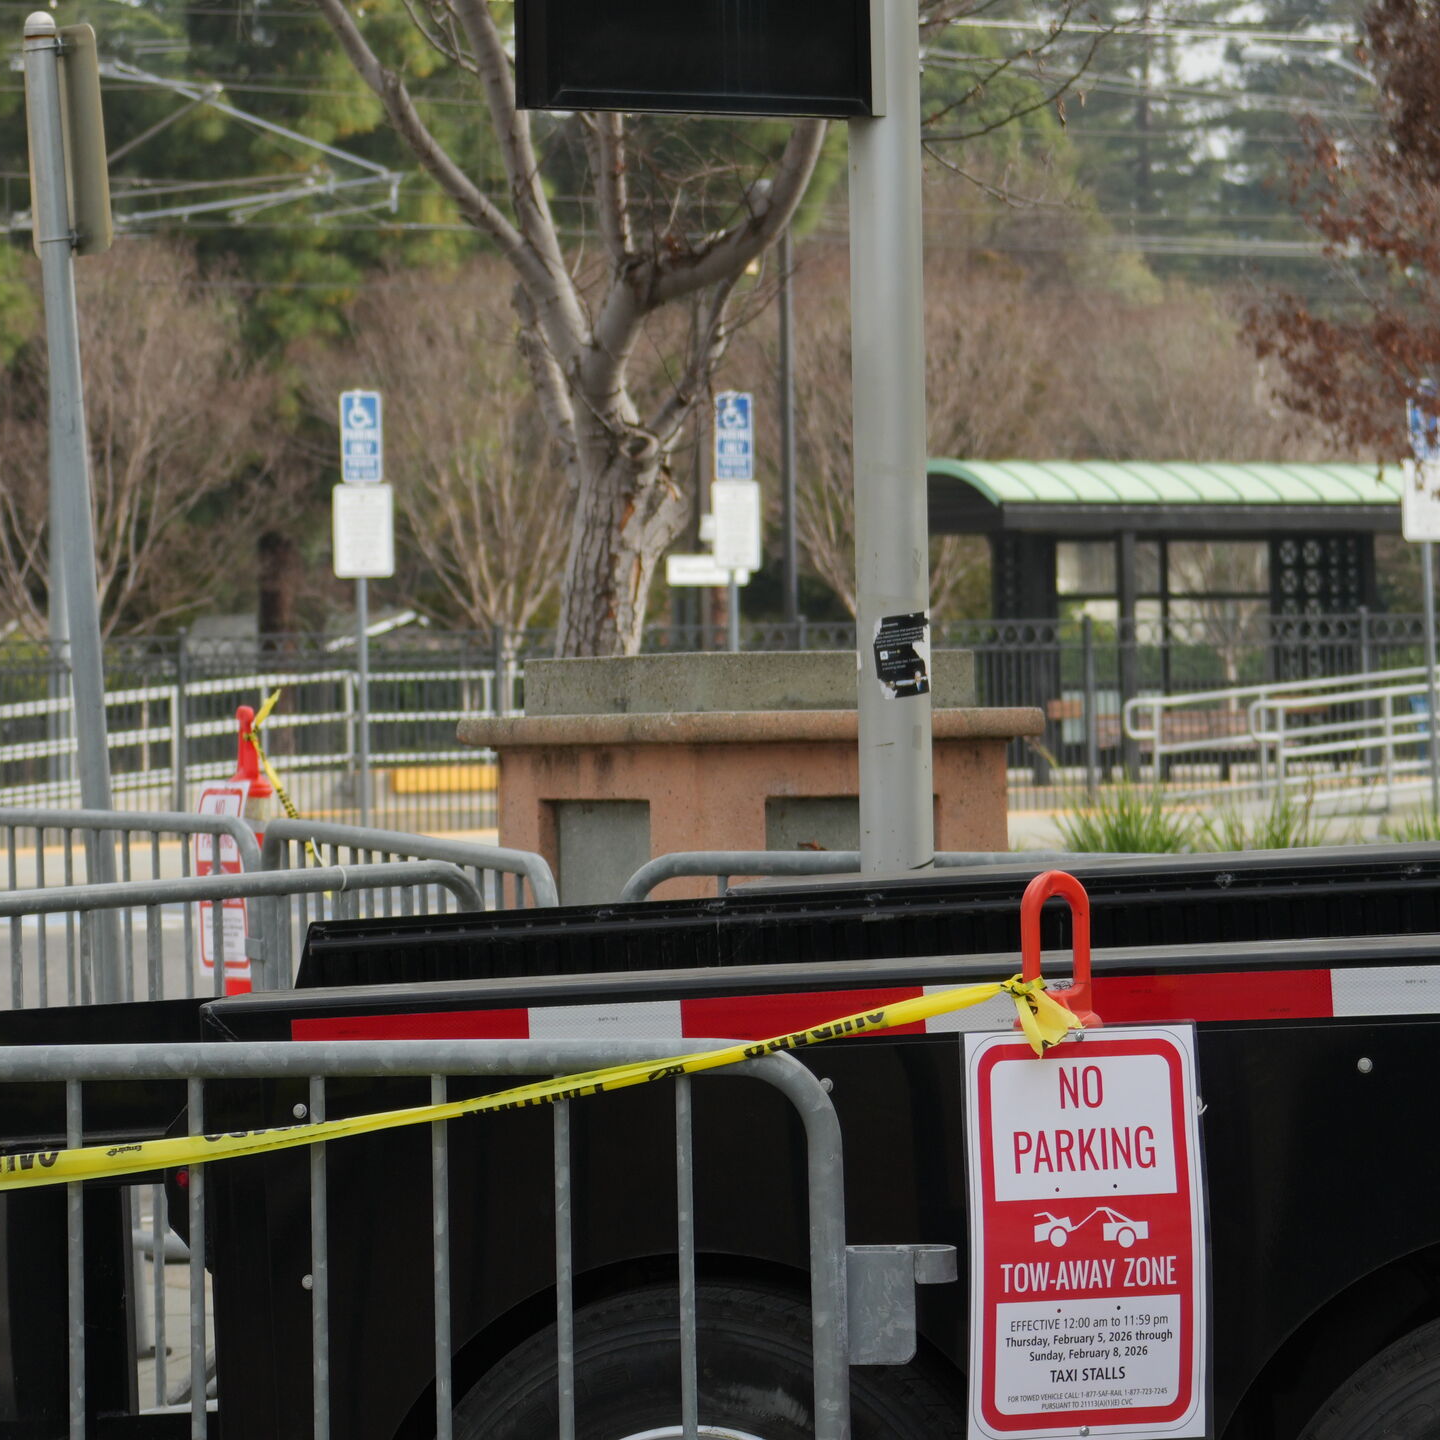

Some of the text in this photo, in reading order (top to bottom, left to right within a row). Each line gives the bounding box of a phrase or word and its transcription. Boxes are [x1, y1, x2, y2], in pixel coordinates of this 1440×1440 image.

[1058, 1065, 1105, 1110] NO
[1013, 1125, 1157, 1175] PARKING
[1000, 1256, 1177, 1294] TOW-AWAY ZONE
[1010, 1314, 1169, 1332] EFFECTIVE 12:00 am to 11:59 pm
[1005, 1329, 1173, 1349] Thursday, February 5, 2026 through
[1029, 1345, 1148, 1362] Sunday, February 8, 2026
[1050, 1366, 1126, 1383] TAXI STALLS
[1020, 1394, 1040, 1402] TOWED
[1041, 1393, 1063, 1401] VEHICLE
[1064, 1391, 1080, 1399] CALL:
[1080, 1389, 1123, 1398] 1-877-SAF-RAIL
[1124, 1387, 1168, 1396] 1-877-723-7245
[1041, 1402, 1071, 1410] PURSUANT
[1072, 1401, 1080, 1409] TO
[1121, 1398, 1133, 1406] CVC
